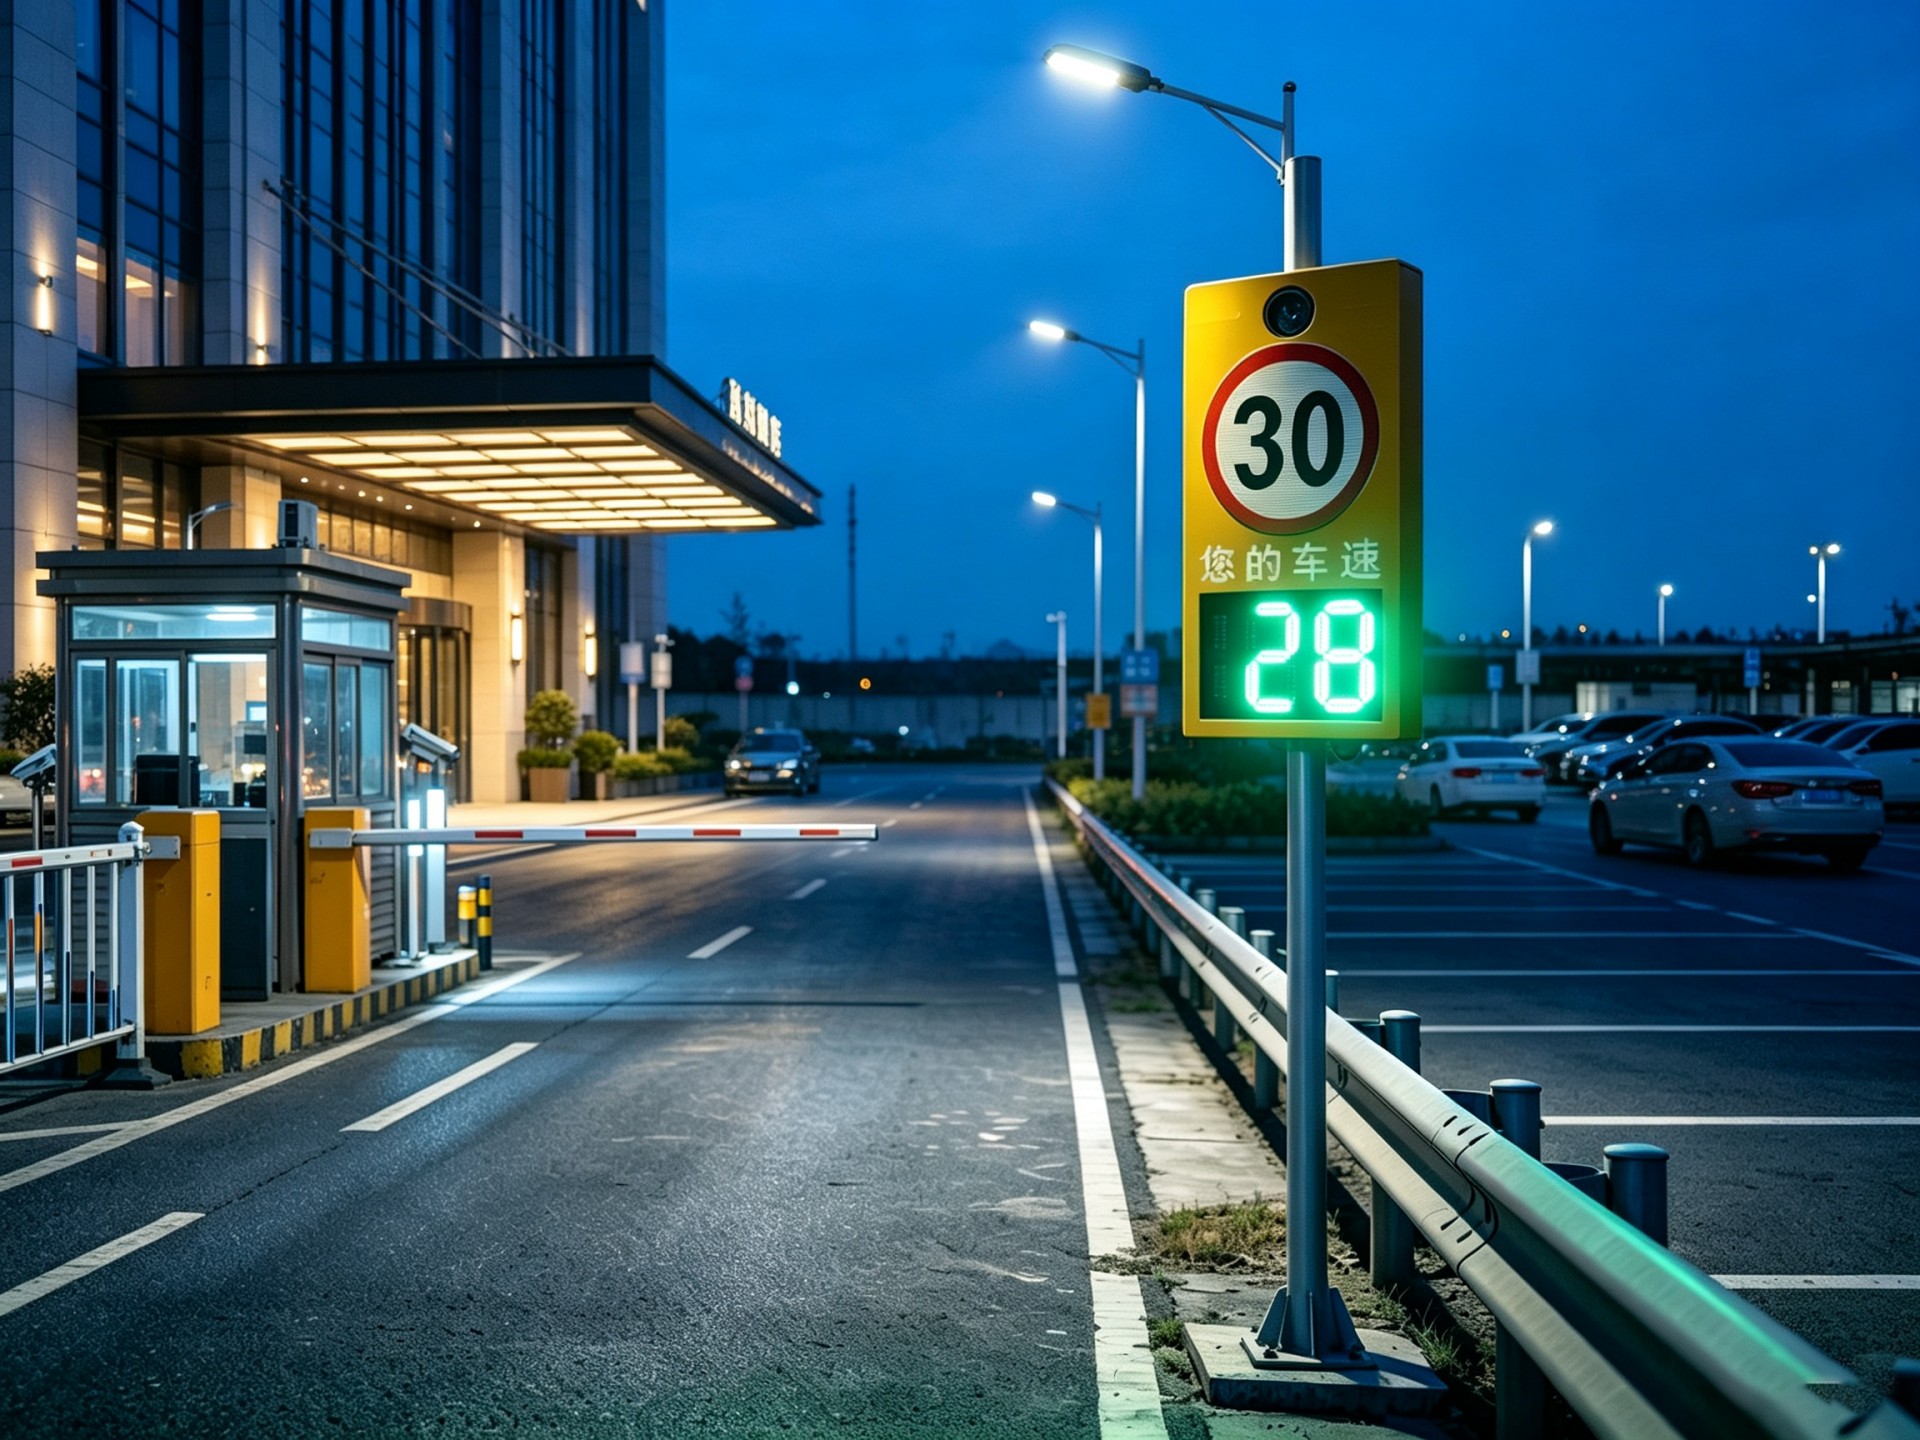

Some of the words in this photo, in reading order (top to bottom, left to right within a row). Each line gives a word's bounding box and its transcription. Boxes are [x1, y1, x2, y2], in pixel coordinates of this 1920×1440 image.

[1233, 390, 1345, 490] 30
[1199, 538, 1381, 583] 您的车速
[1245, 599, 1375, 713] 28
